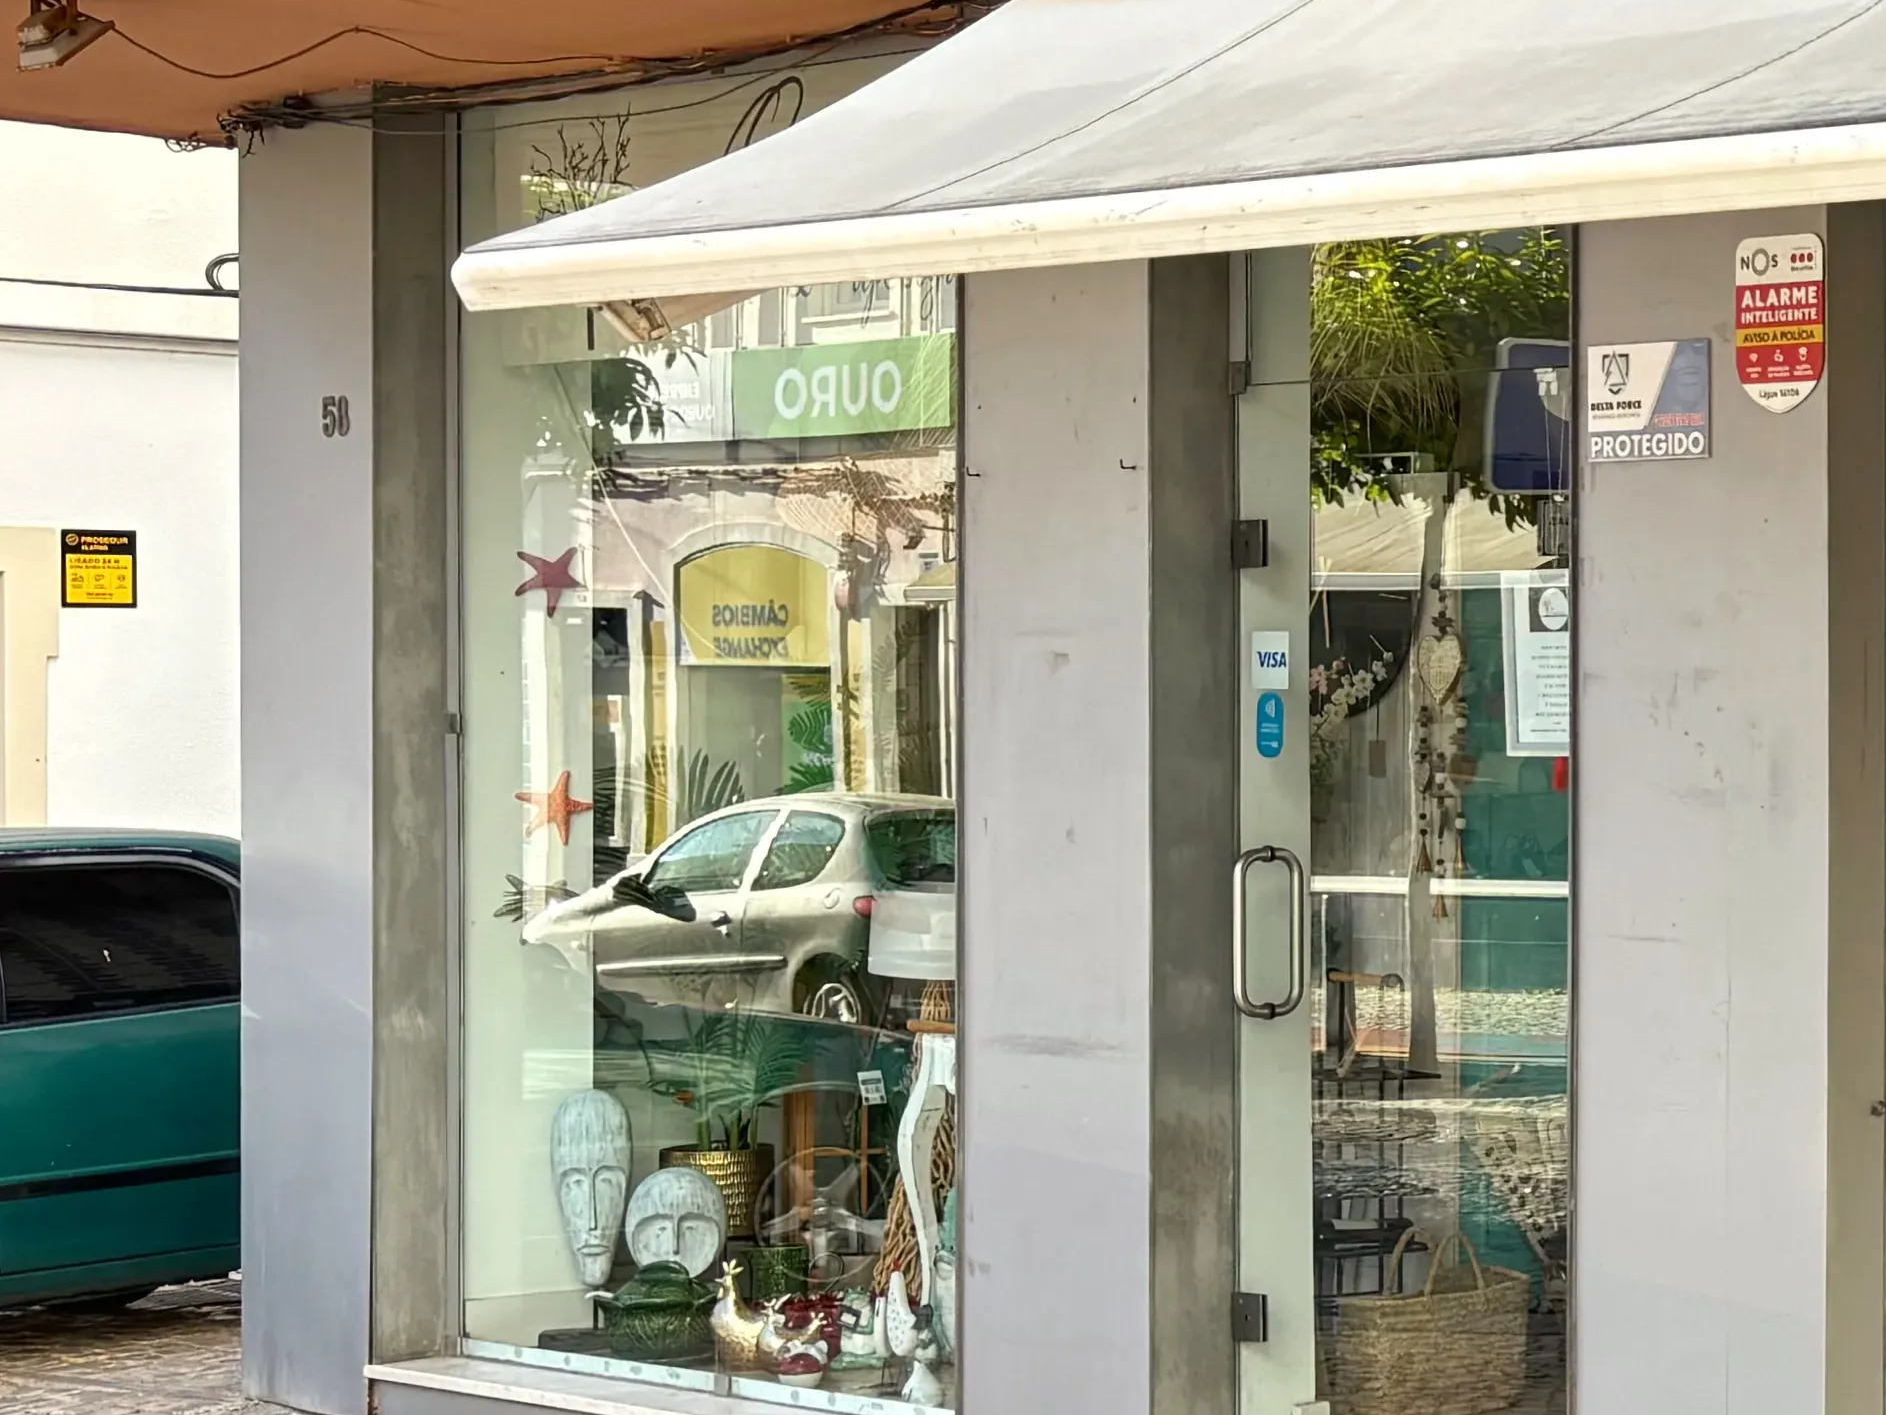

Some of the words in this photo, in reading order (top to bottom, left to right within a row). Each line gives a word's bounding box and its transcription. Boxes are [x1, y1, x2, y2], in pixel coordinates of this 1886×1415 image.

[1740, 248, 1779, 277] NOS
[1741, 285, 1818, 309] ALARME
[1741, 307, 1818, 325] INTELIGENTE
[1743, 331, 1770, 344] AVISO
[1779, 328, 1815, 342] POLÍCIA
[1590, 400, 1614, 412] DELTA
[1616, 399, 1642, 411] FORCE
[322, 395, 350, 438] 58
[1591, 431, 1705, 458] PROTEGIDO
[1257, 651, 1287, 668] VISA
